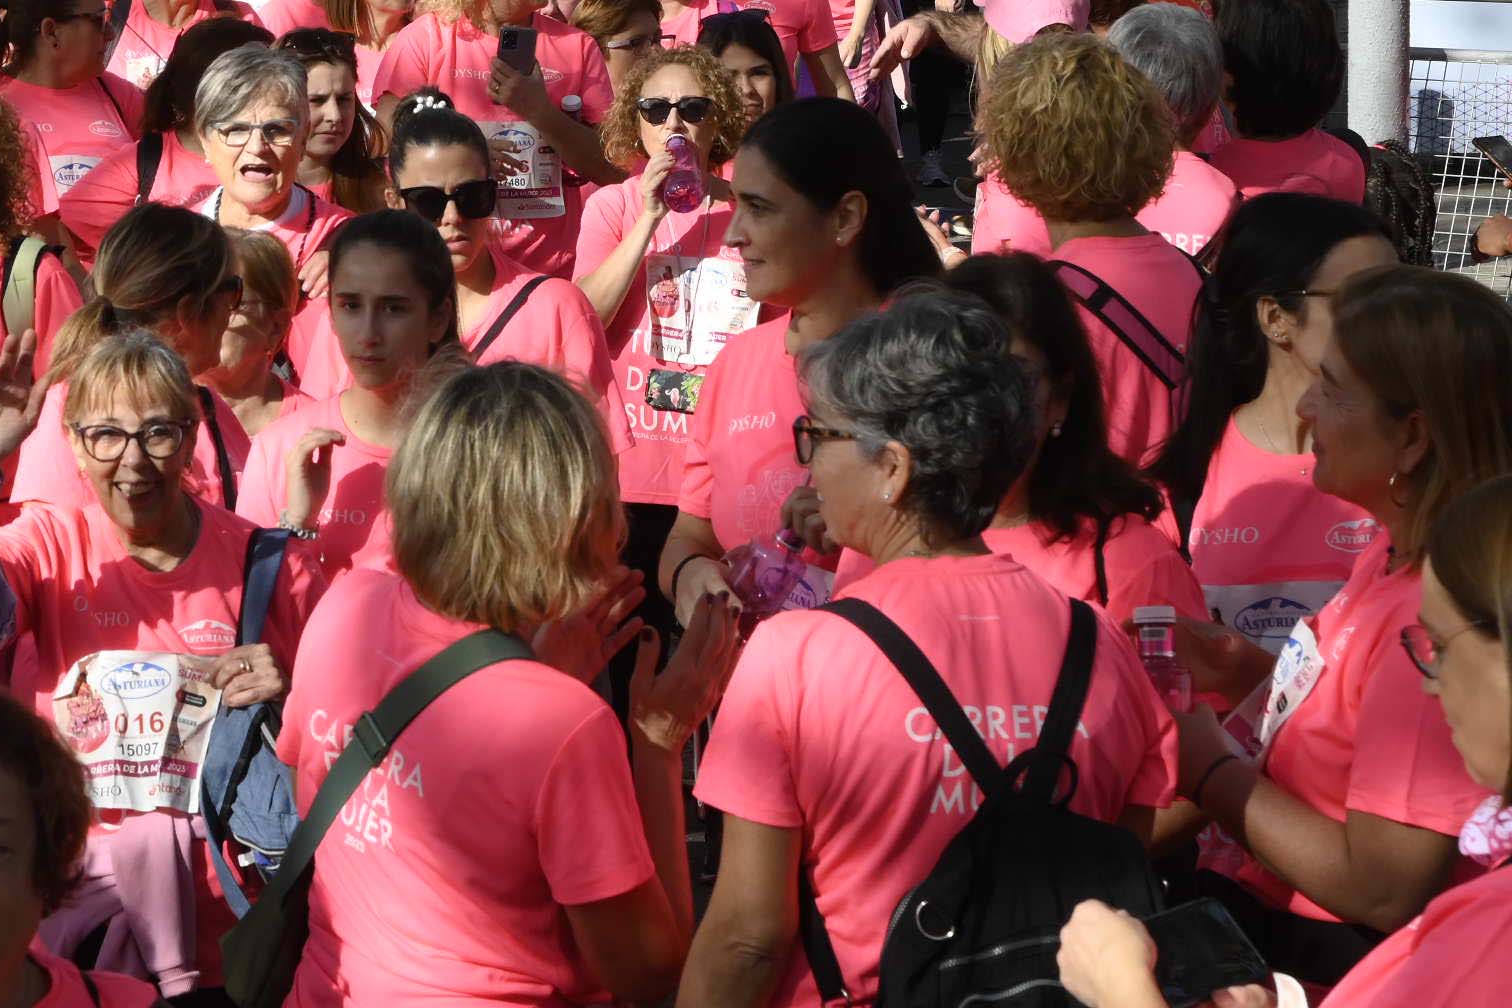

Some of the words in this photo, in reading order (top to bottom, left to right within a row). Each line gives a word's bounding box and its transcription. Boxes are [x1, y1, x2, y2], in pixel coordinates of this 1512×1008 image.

[625, 403, 688, 434] SUM
[1329, 531, 1375, 545] ASTURI
[1242, 612, 1298, 628] ASTURIA
[114, 711, 165, 737] 016
[119, 742, 159, 757] 15097
[90, 762, 121, 774] RRERA
[123, 764, 136, 774] DE
[137, 764, 149, 774] LA
[93, 785, 122, 796] SHO
